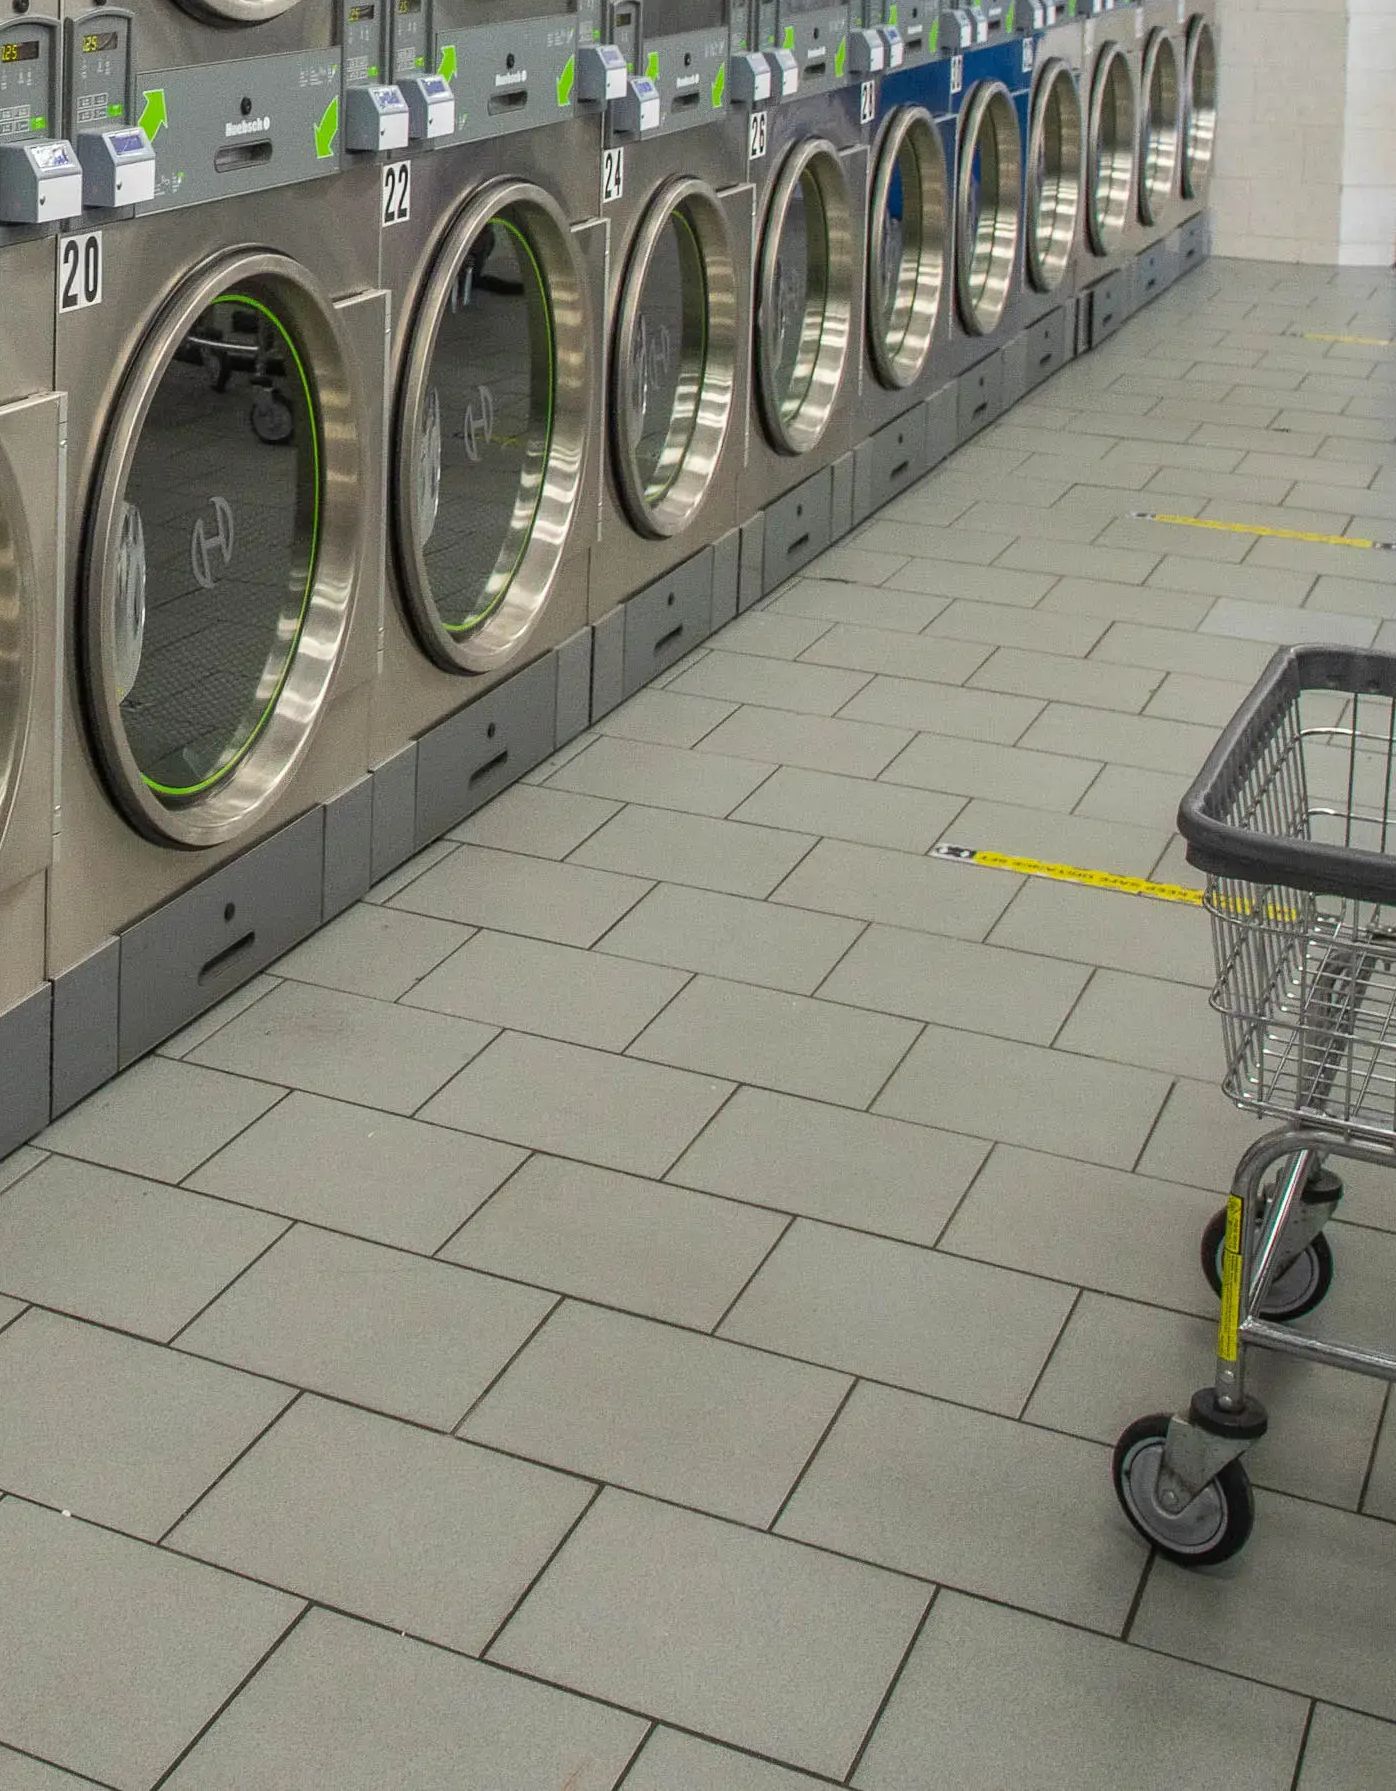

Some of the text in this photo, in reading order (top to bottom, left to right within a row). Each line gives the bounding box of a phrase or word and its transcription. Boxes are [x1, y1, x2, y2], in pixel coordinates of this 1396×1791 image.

[751, 114, 765, 156] 26
[384, 164, 408, 223] 22
[605, 150, 621, 199] 24
[62, 236, 98, 308] 20
